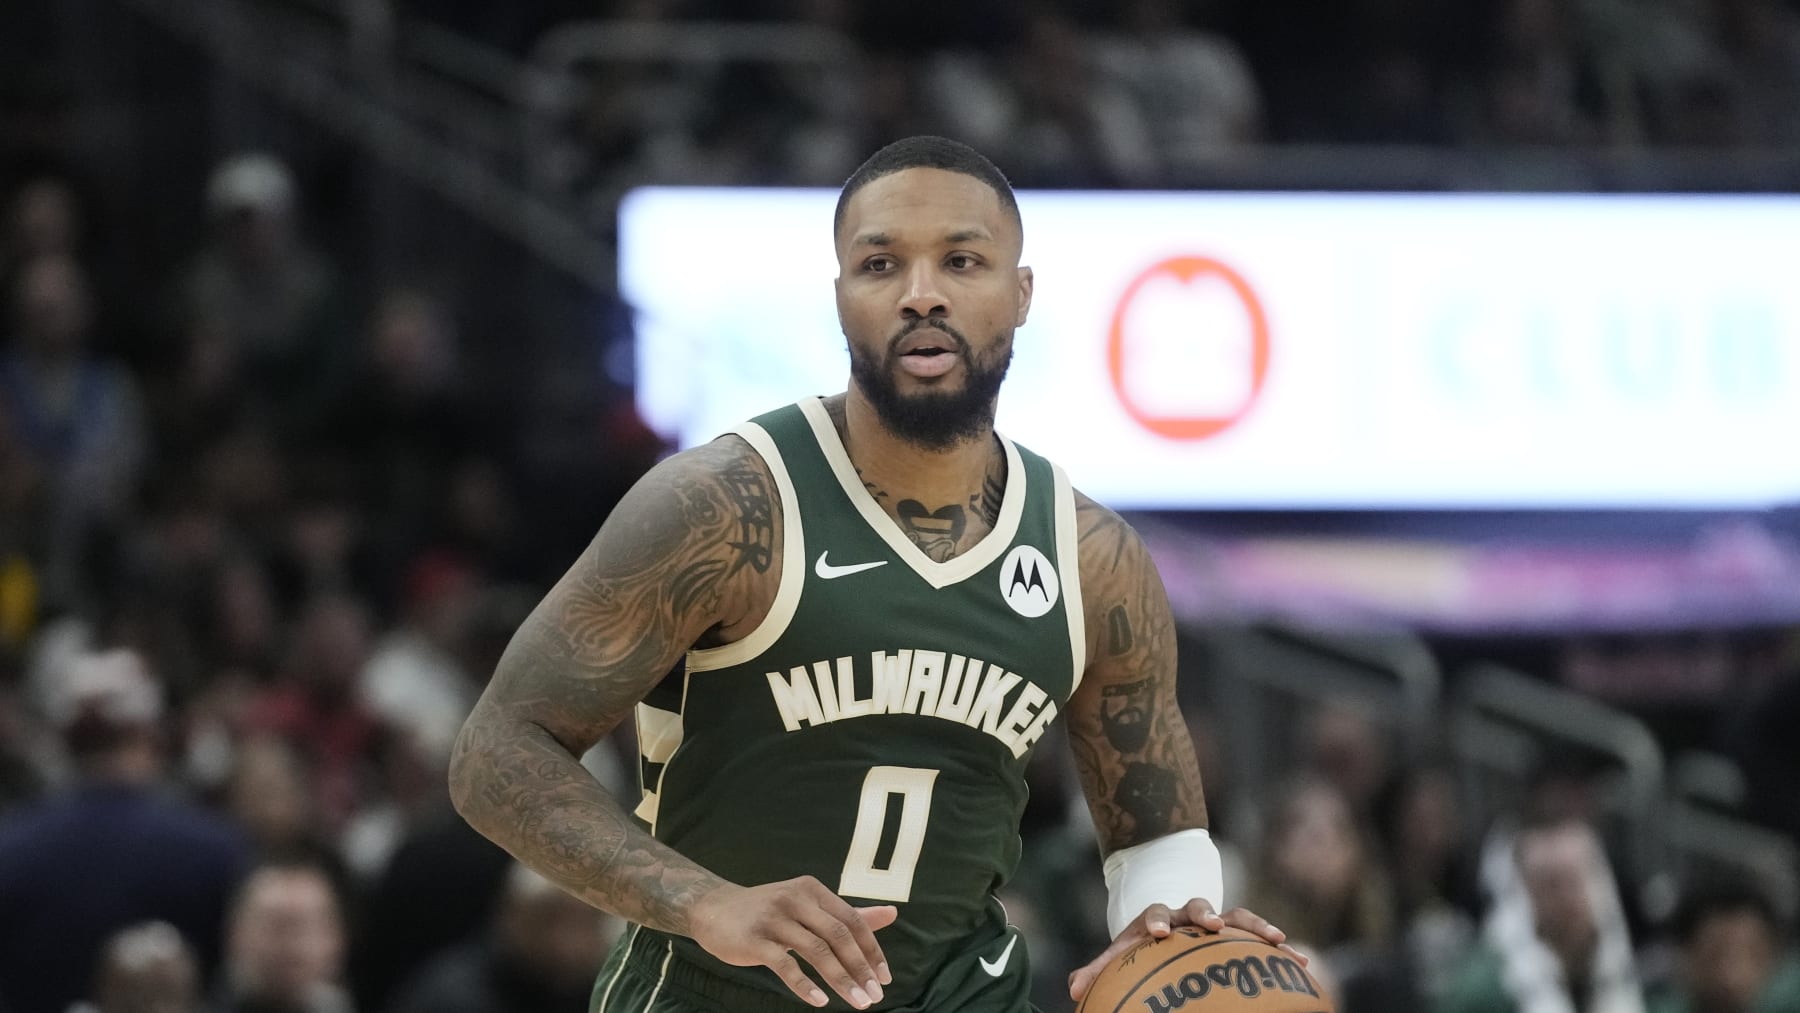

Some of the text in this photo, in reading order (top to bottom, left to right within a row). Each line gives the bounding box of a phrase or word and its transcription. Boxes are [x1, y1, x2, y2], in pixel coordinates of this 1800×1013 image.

[767, 649, 1056, 760] MILWAUKEE
[838, 766, 940, 902] 0
[1144, 954, 1320, 1012] Wilson
